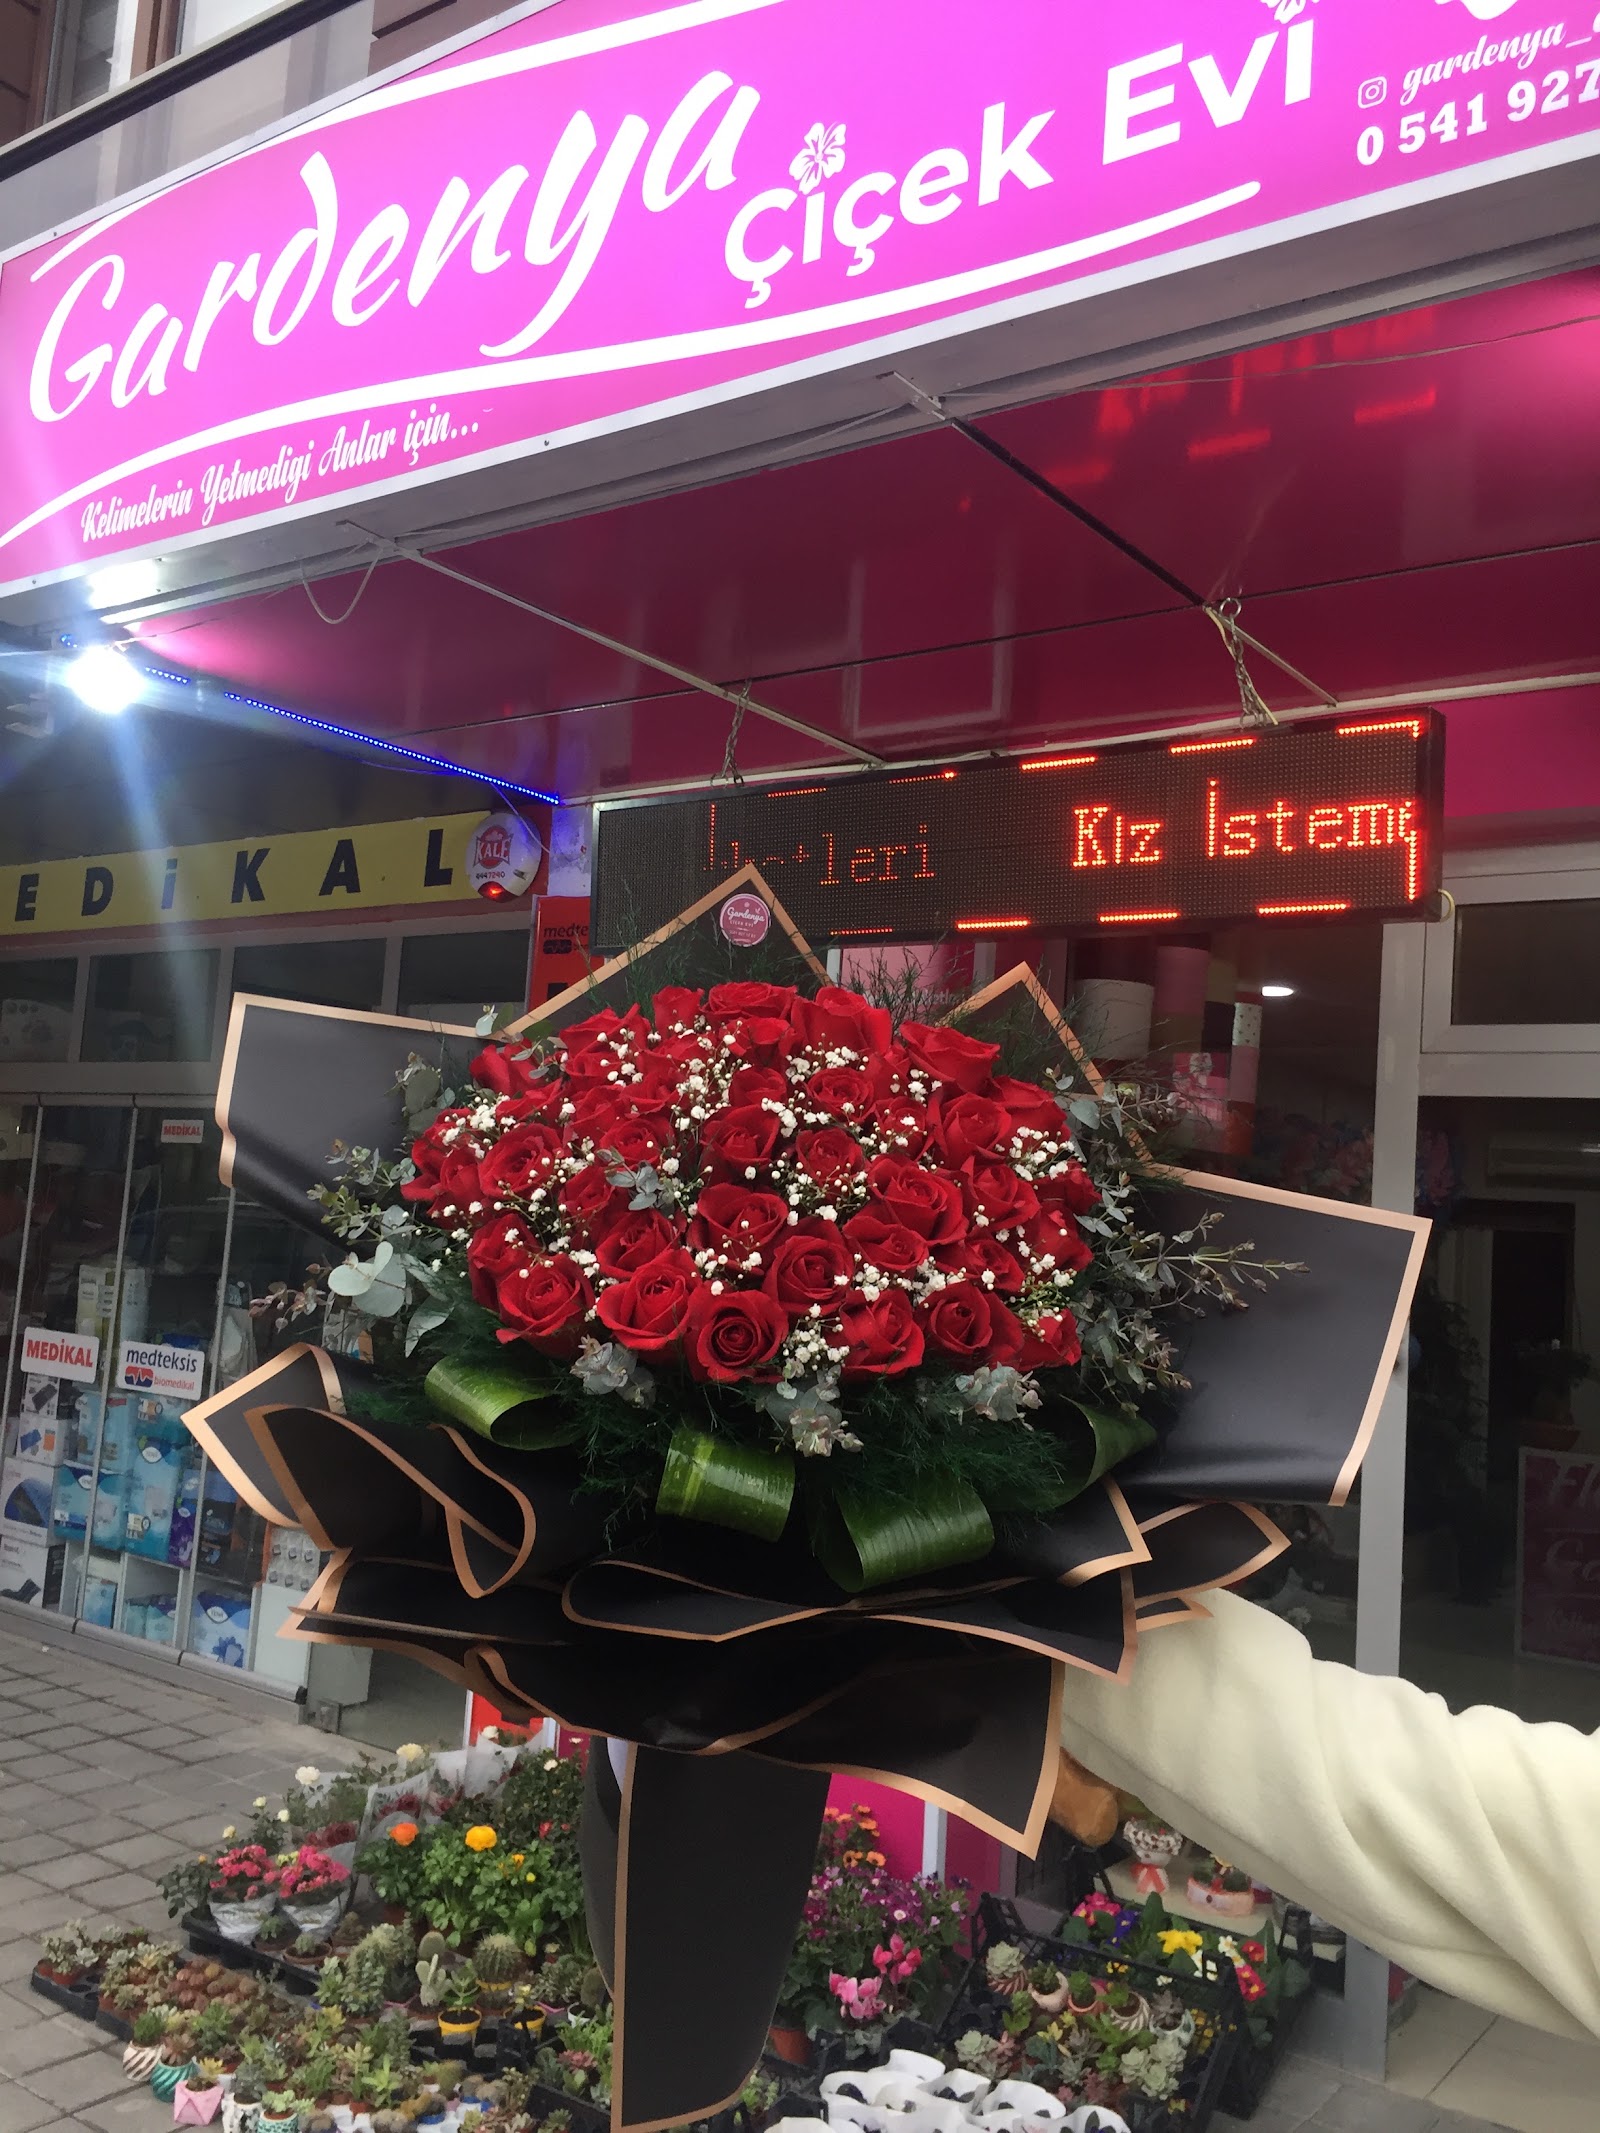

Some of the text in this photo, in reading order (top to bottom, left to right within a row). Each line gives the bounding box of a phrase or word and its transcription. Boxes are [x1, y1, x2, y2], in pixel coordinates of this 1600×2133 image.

[1356, 57, 1600, 166] 0 541 927
[724, 8, 1314, 309] Çiçek Evi
[30, 70, 761, 422] Gardenya
[81, 479, 195, 543] Kelimelerin
[318, 420, 398, 475] Anlar
[403, 402, 480, 466] için...
[475, 836, 511, 863] KALE
[726, 906, 765, 925] Gardenya
[163, 1124, 202, 1137] MEDİKAL
[26, 1338, 94, 1368] MEDİKAL
[126, 1348, 197, 1373] medteksis
[153, 1375, 195, 1391] biomedikal
